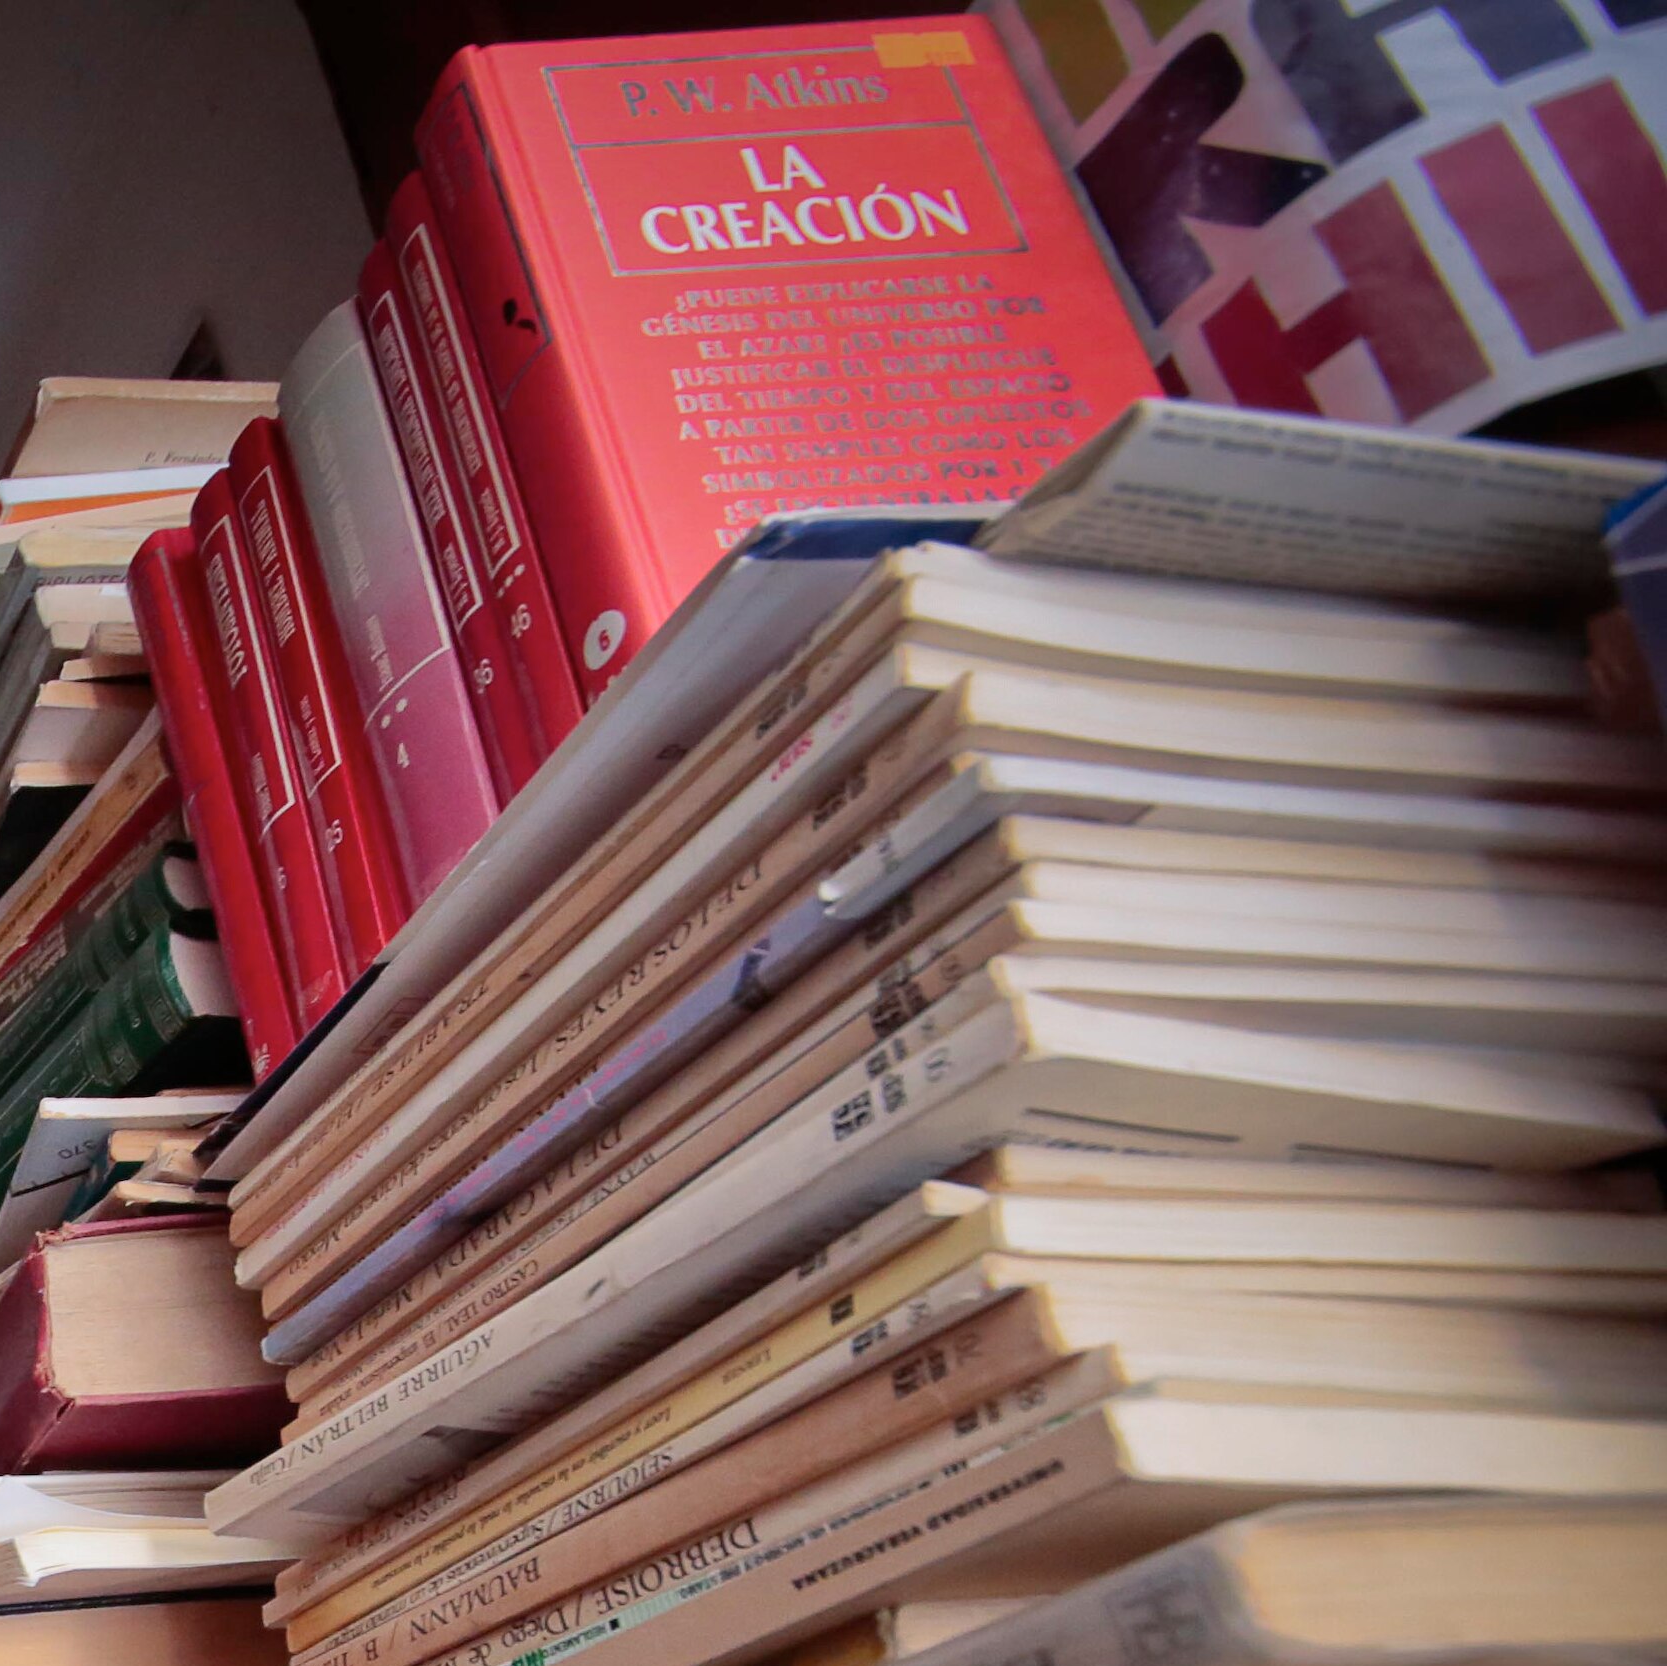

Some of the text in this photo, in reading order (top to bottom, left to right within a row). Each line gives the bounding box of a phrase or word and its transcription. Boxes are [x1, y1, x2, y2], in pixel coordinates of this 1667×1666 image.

[663, 66, 890, 113] W. Atkins
[740, 145, 826, 193] LA
[640, 183, 971, 255] CREACIÓN
[641, 296, 1048, 337] GÉNESIS DEL UNIVERSO POR
[676, 274, 994, 313] ¿PUEDE EXPLICARSE LA
[698, 324, 1009, 360] EL POSIBLE
[670, 359, 871, 390] JUSTIFICAR EL
[676, 374, 1071, 415] DEL TIEMPO DEL ESPACIO
[866, 410, 928, 430] DOS
[911, 432, 1007, 455] COMO
[248, 499, 278, 566] ANIMAL
[265, 574, 297, 646] HOMBRE
[547, 963, 647, 1051] REYES
[443, 1259, 540, 1331] CASTRO LEAL
[299, 1328, 496, 1459] AGUIRRE BELTRÁN
[792, 1457, 1065, 1590] UNIVERSIDAD VERACRUZANA
[588, 1516, 759, 1614] DEBROISE
[406, 1556, 543, 1641] BAUMANN
[497, 1605, 569, 1651] Diego
